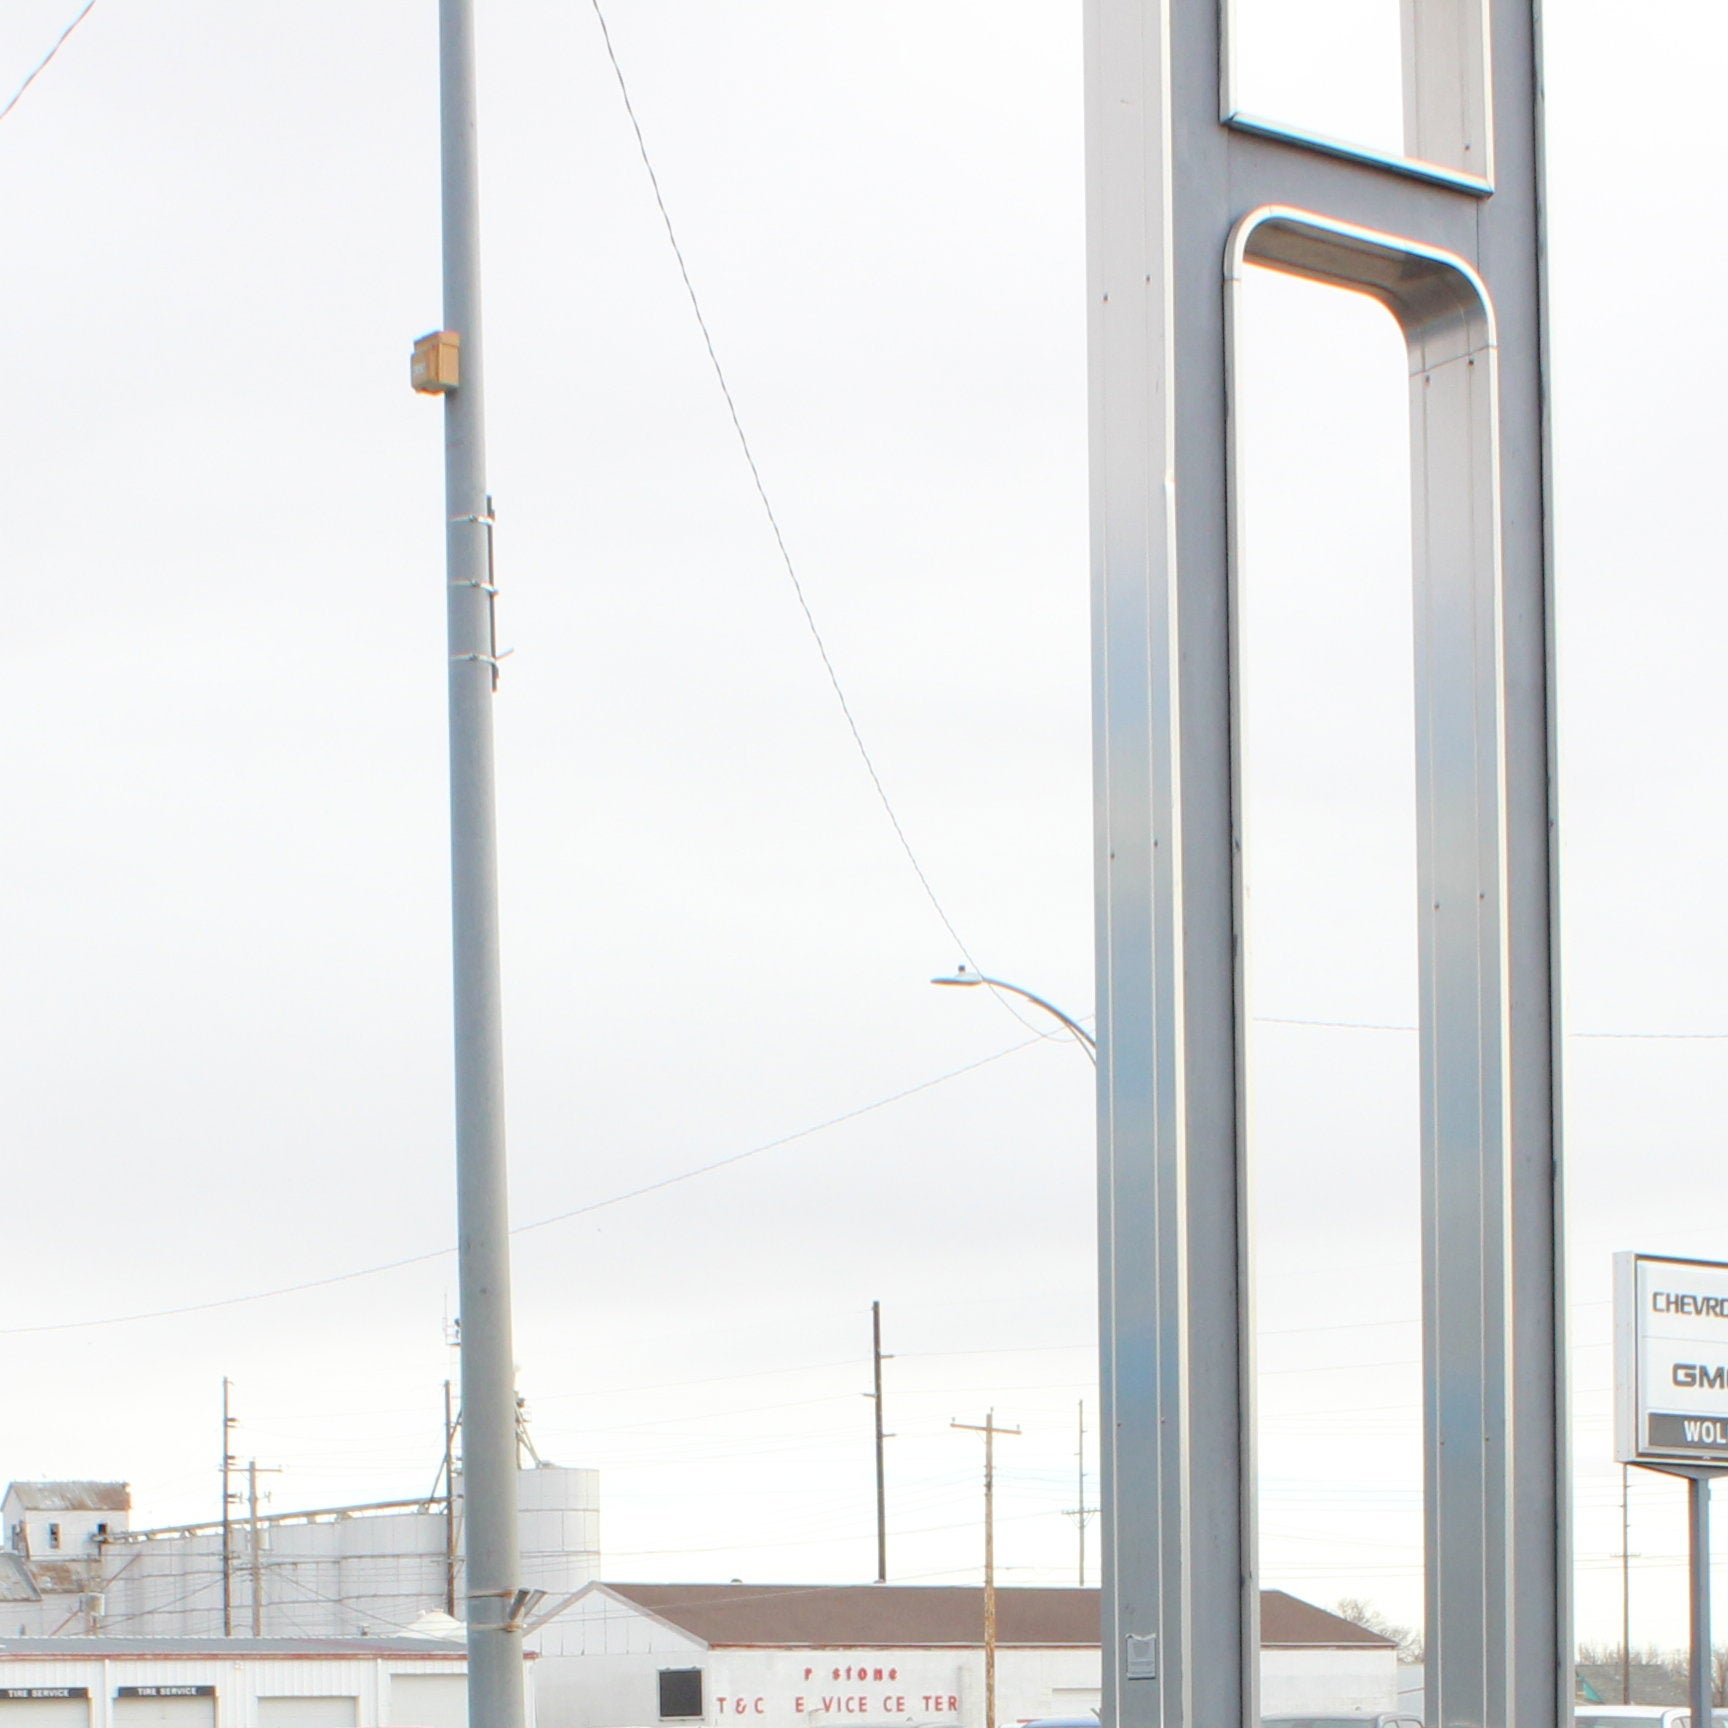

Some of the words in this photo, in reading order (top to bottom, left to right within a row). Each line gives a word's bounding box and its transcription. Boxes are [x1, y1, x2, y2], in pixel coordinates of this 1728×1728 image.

[8, 1689, 28, 1698] TIRE
[31, 1689, 70, 1698] SERVICE
[137, 1687, 157, 1696] TIRE
[159, 1687, 197, 1695] SERVICE
